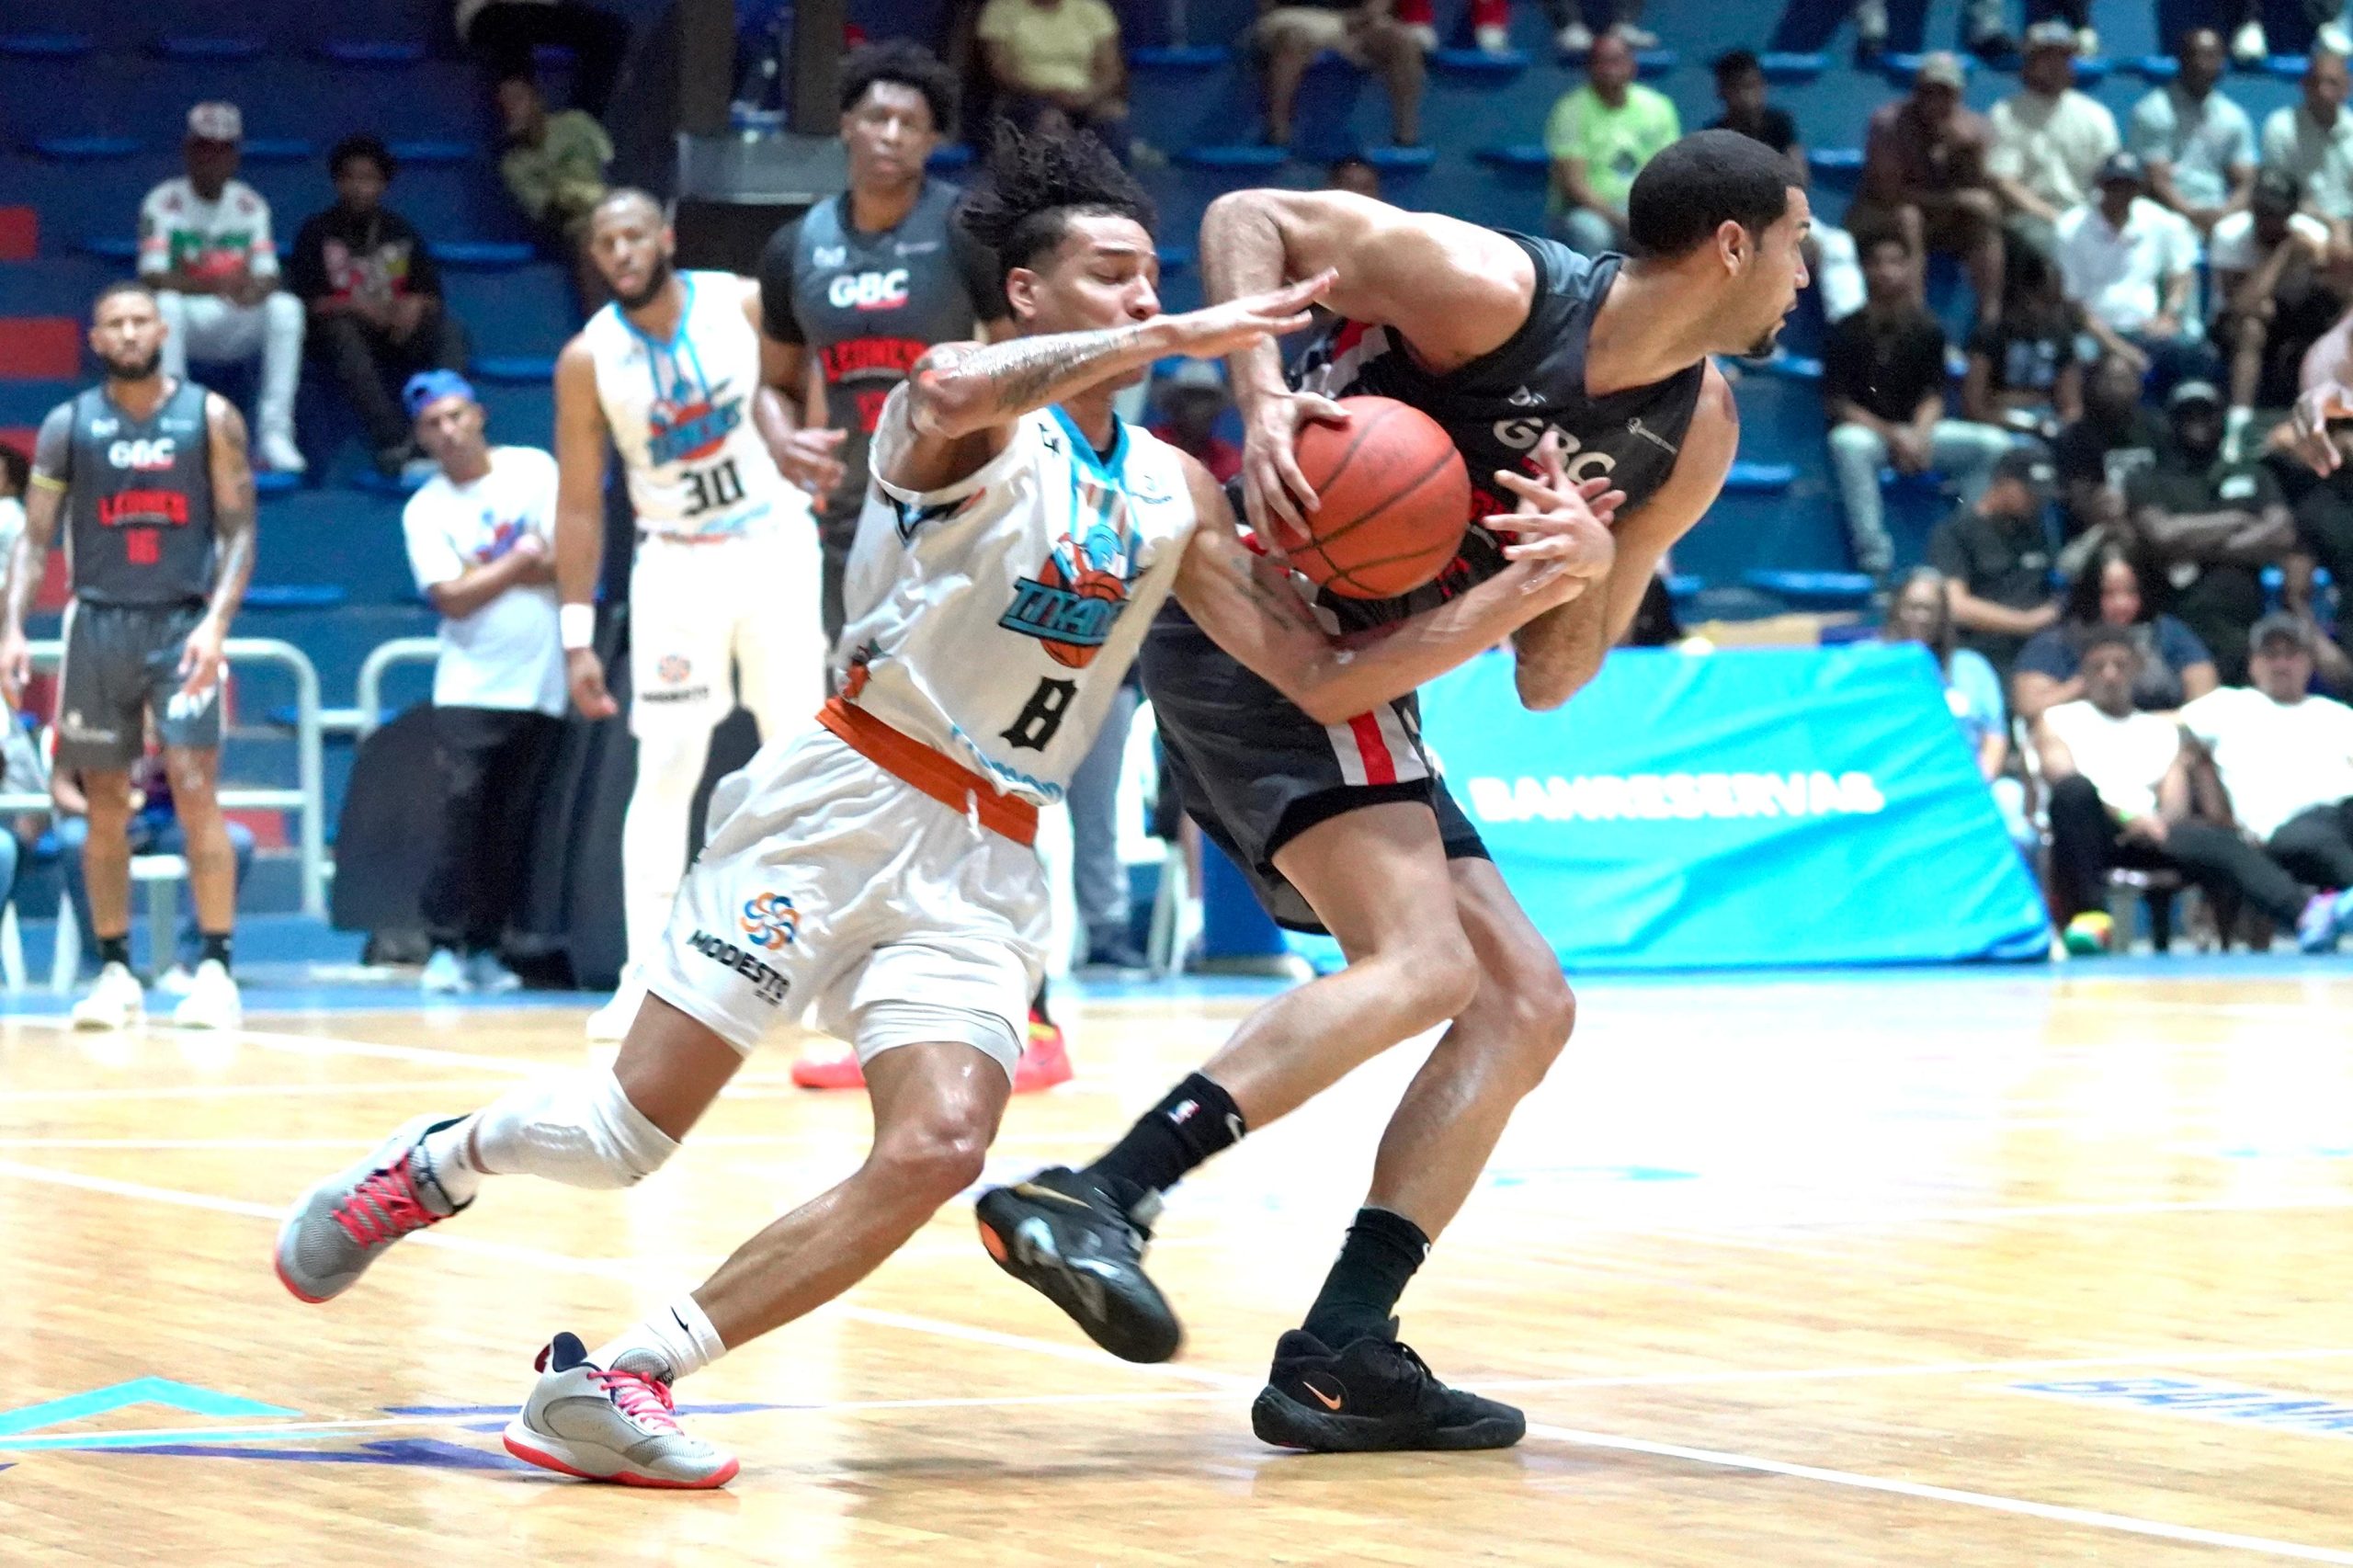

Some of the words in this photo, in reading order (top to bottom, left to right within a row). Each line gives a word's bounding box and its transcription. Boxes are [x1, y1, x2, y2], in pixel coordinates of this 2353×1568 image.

[680, 458, 745, 517] 30
[999, 676, 1079, 753] 8
[686, 928, 790, 1000] MODESTO
